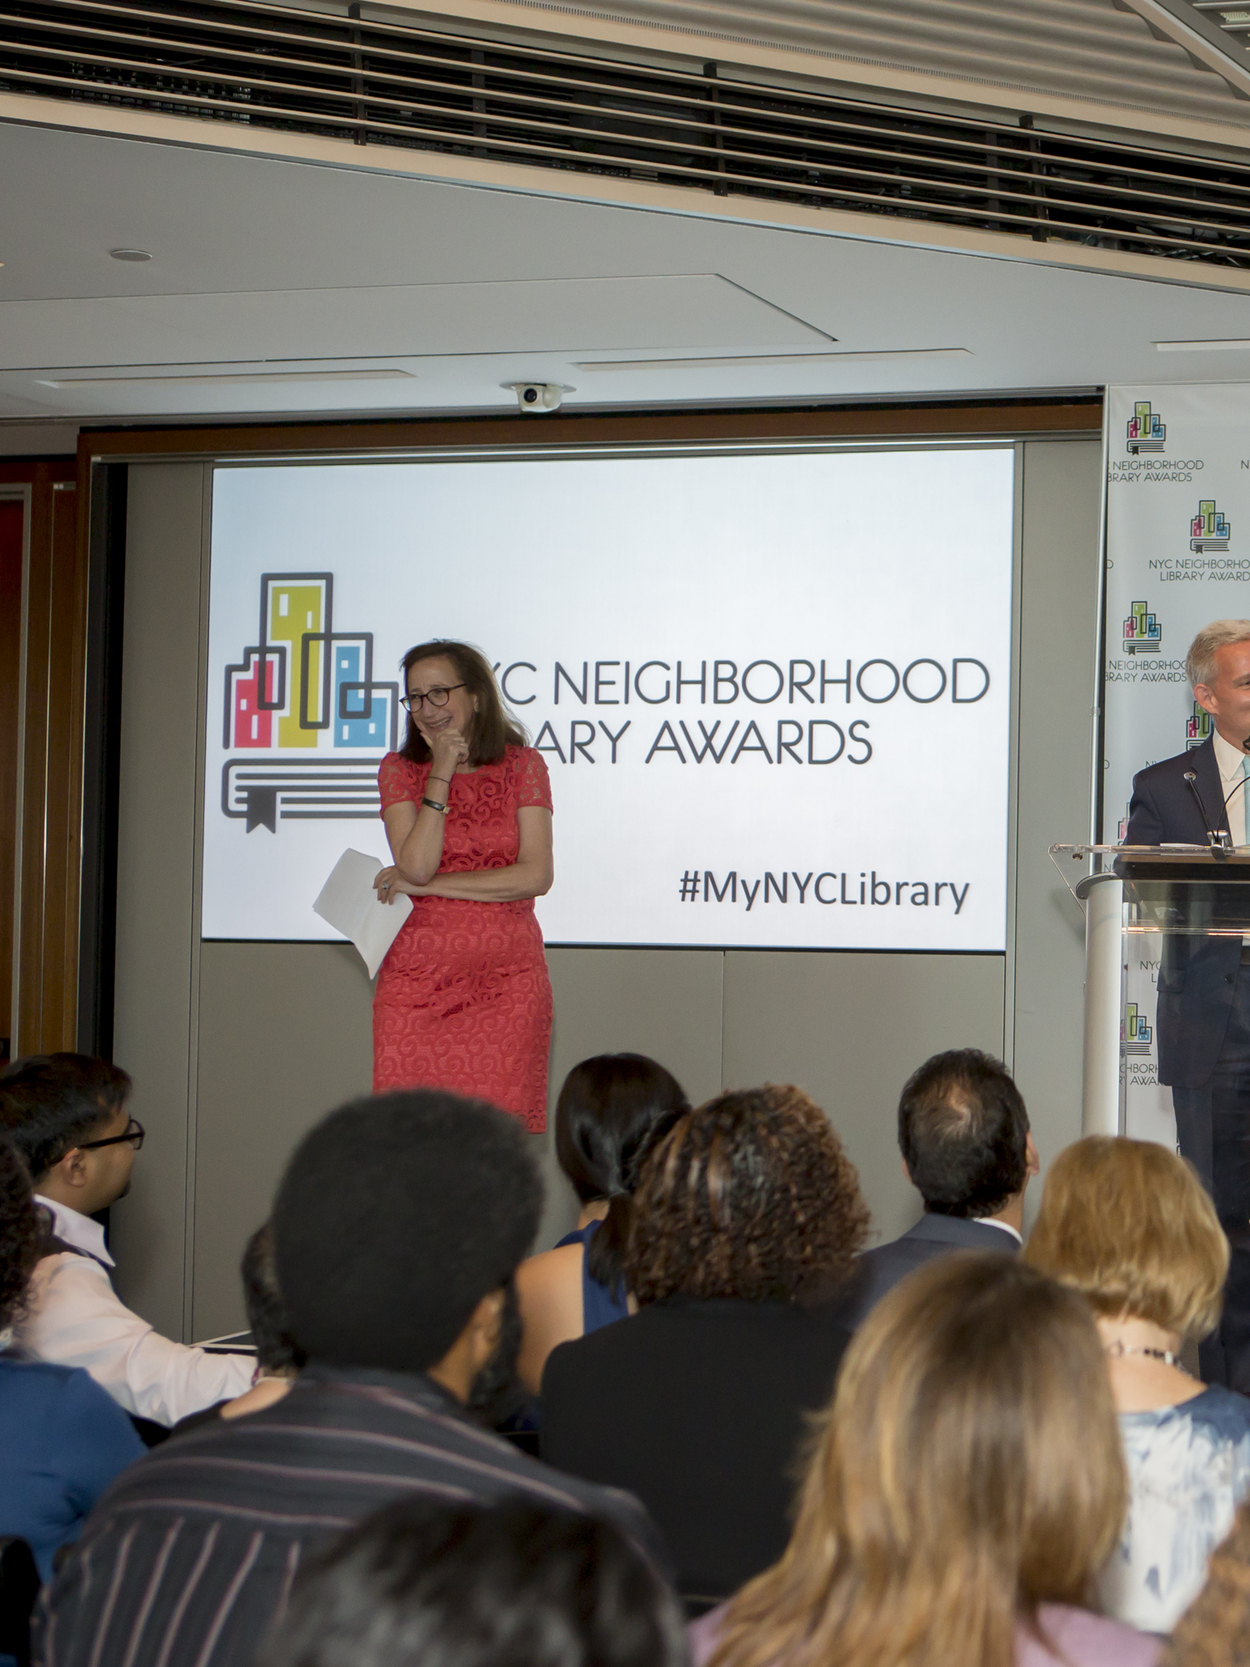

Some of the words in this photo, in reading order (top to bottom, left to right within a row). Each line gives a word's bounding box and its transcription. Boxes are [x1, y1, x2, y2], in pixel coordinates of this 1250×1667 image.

[1113, 460, 1204, 470] NEIGHBORHOOD
[1108, 473, 1141, 482] BRARY
[1144, 472, 1192, 482] AWARDS
[1149, 559, 1172, 569] NYC
[1160, 571, 1204, 581] LIBRARY
[554, 658, 990, 705] NEIGHBORHOOD
[1105, 672, 1136, 682] BRARY
[1140, 672, 1187, 682] AWARDS
[645, 719, 872, 766] AWARDS
[679, 870, 970, 915] #MyNYCLibrary
